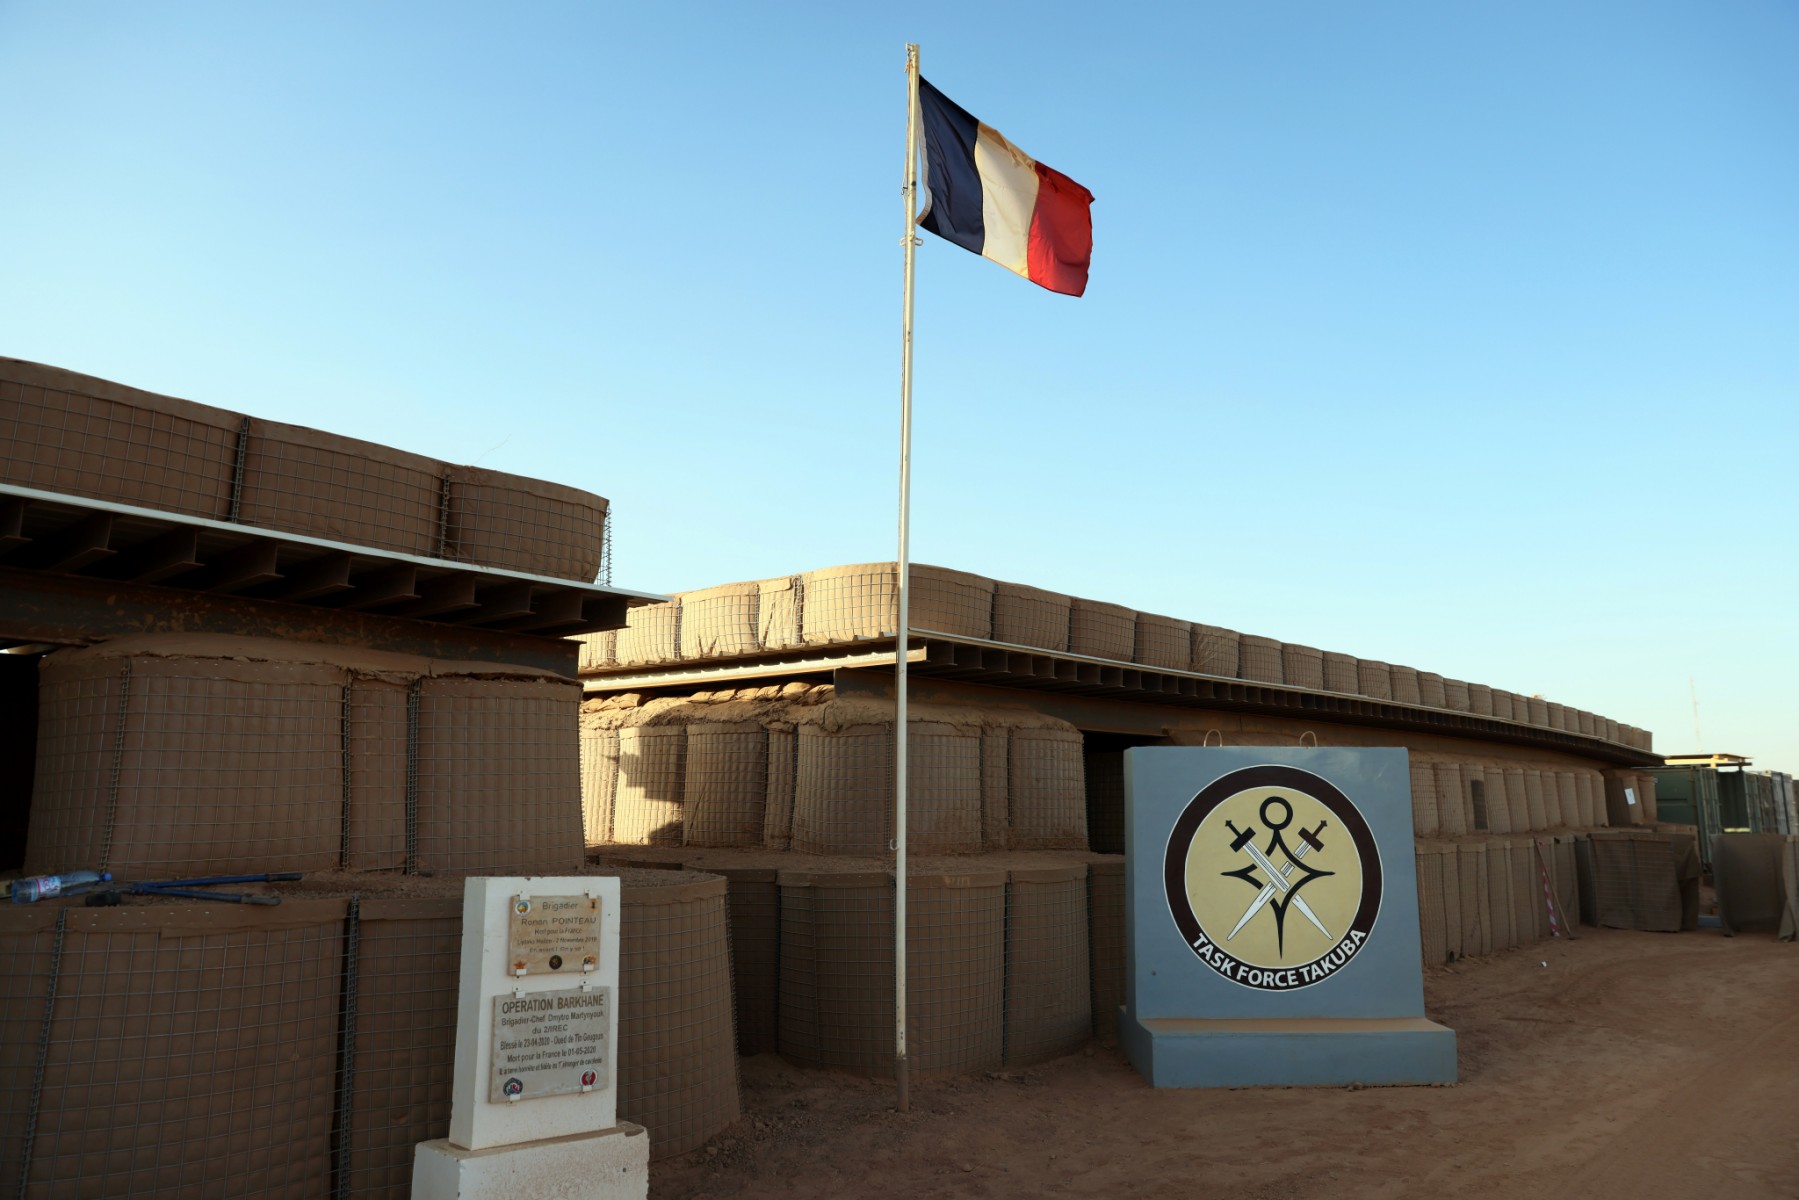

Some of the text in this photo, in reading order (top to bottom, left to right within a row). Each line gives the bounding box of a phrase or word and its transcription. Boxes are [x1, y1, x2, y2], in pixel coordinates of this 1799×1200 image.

[542, 901, 578, 912] Brigadier
[521, 916, 597, 926] Ronan POINTEAU
[1192, 929, 1366, 987] TASK FORCE TAKUBA
[502, 994, 604, 1014] OPERATION BARKHANE
[502, 1014, 546, 1027] Brigadier-Chef
[548, 1012, 570, 1022] Dmytro
[507, 1054, 520, 1062] Mort
[522, 1054, 534, 1062] pour
[542, 1050, 560, 1059] France
[562, 1048, 567, 1057] le
[568, 1046, 596, 1056] 01-05-2020
